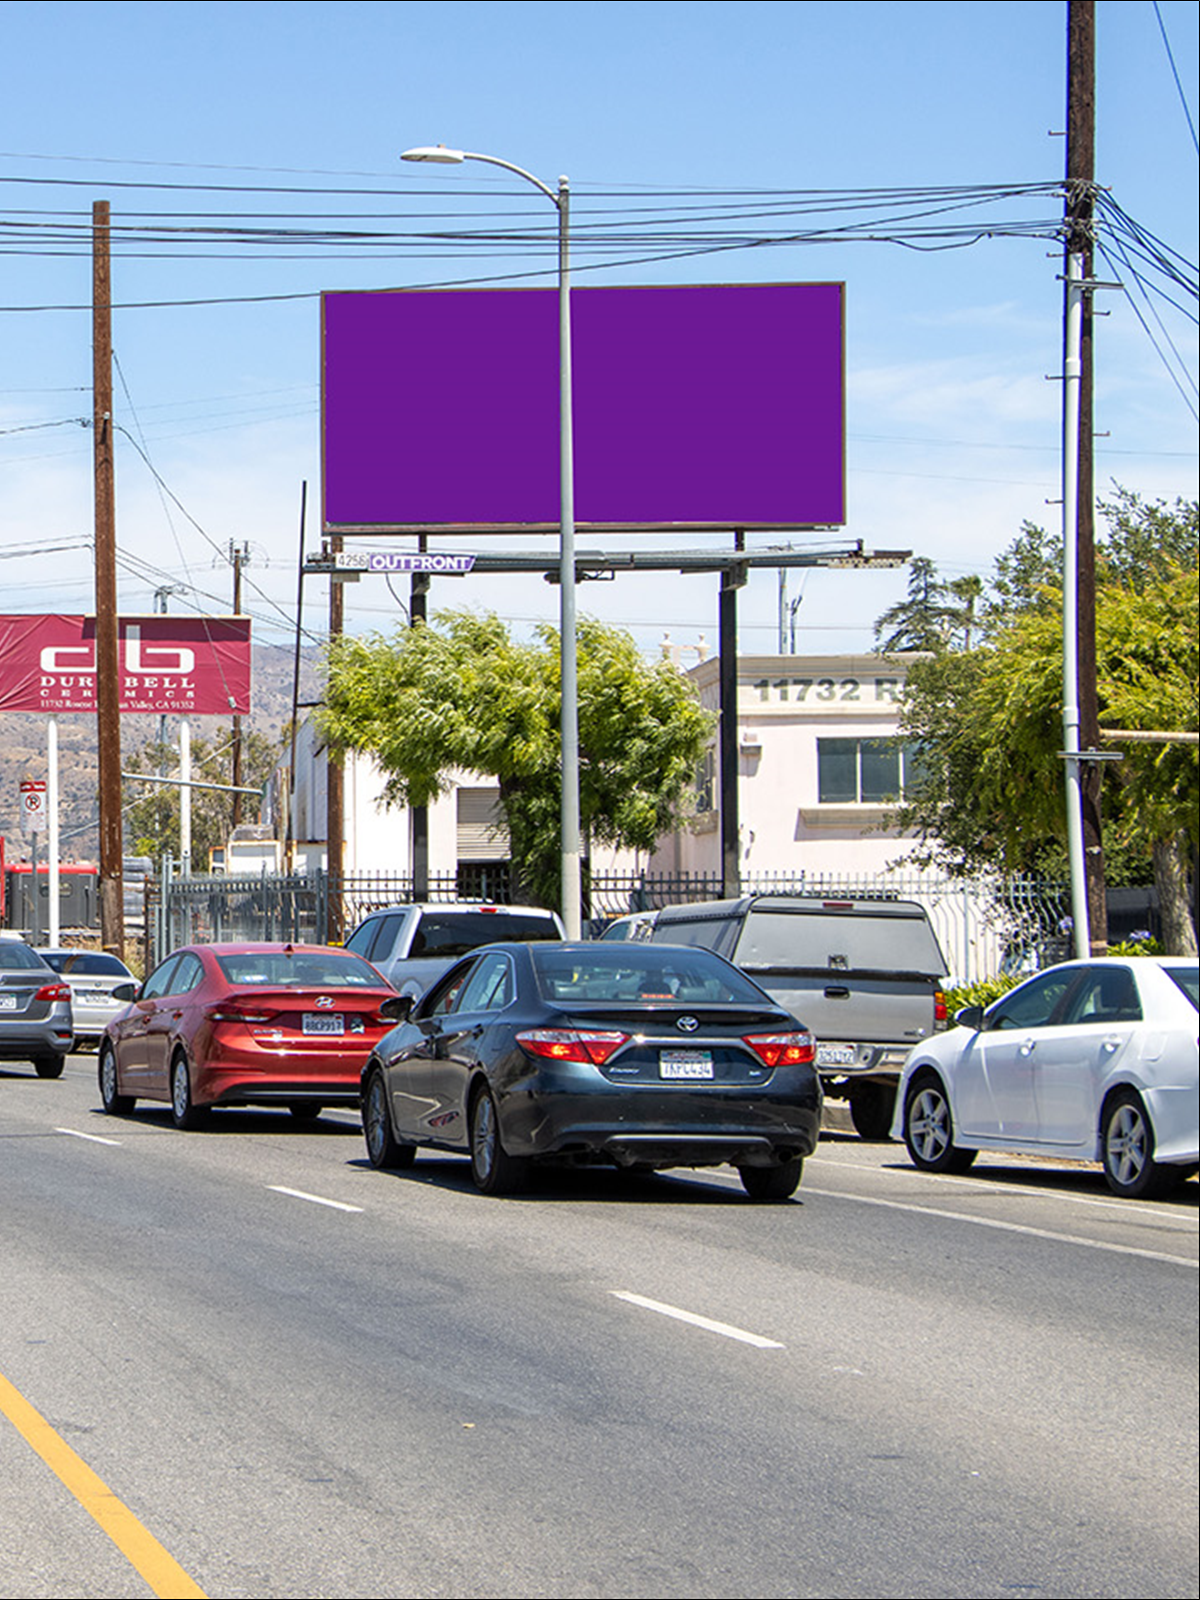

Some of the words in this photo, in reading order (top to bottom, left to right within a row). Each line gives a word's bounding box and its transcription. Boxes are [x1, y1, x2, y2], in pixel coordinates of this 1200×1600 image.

[372, 556, 470, 569] OUTFRONT
[40, 676, 195, 689] DURBELL
[40, 690, 195, 699] CERMICS
[753, 678, 860, 702] 11732
[65, 700, 92, 708] Roscoe
[156, 700, 169, 709] CA
